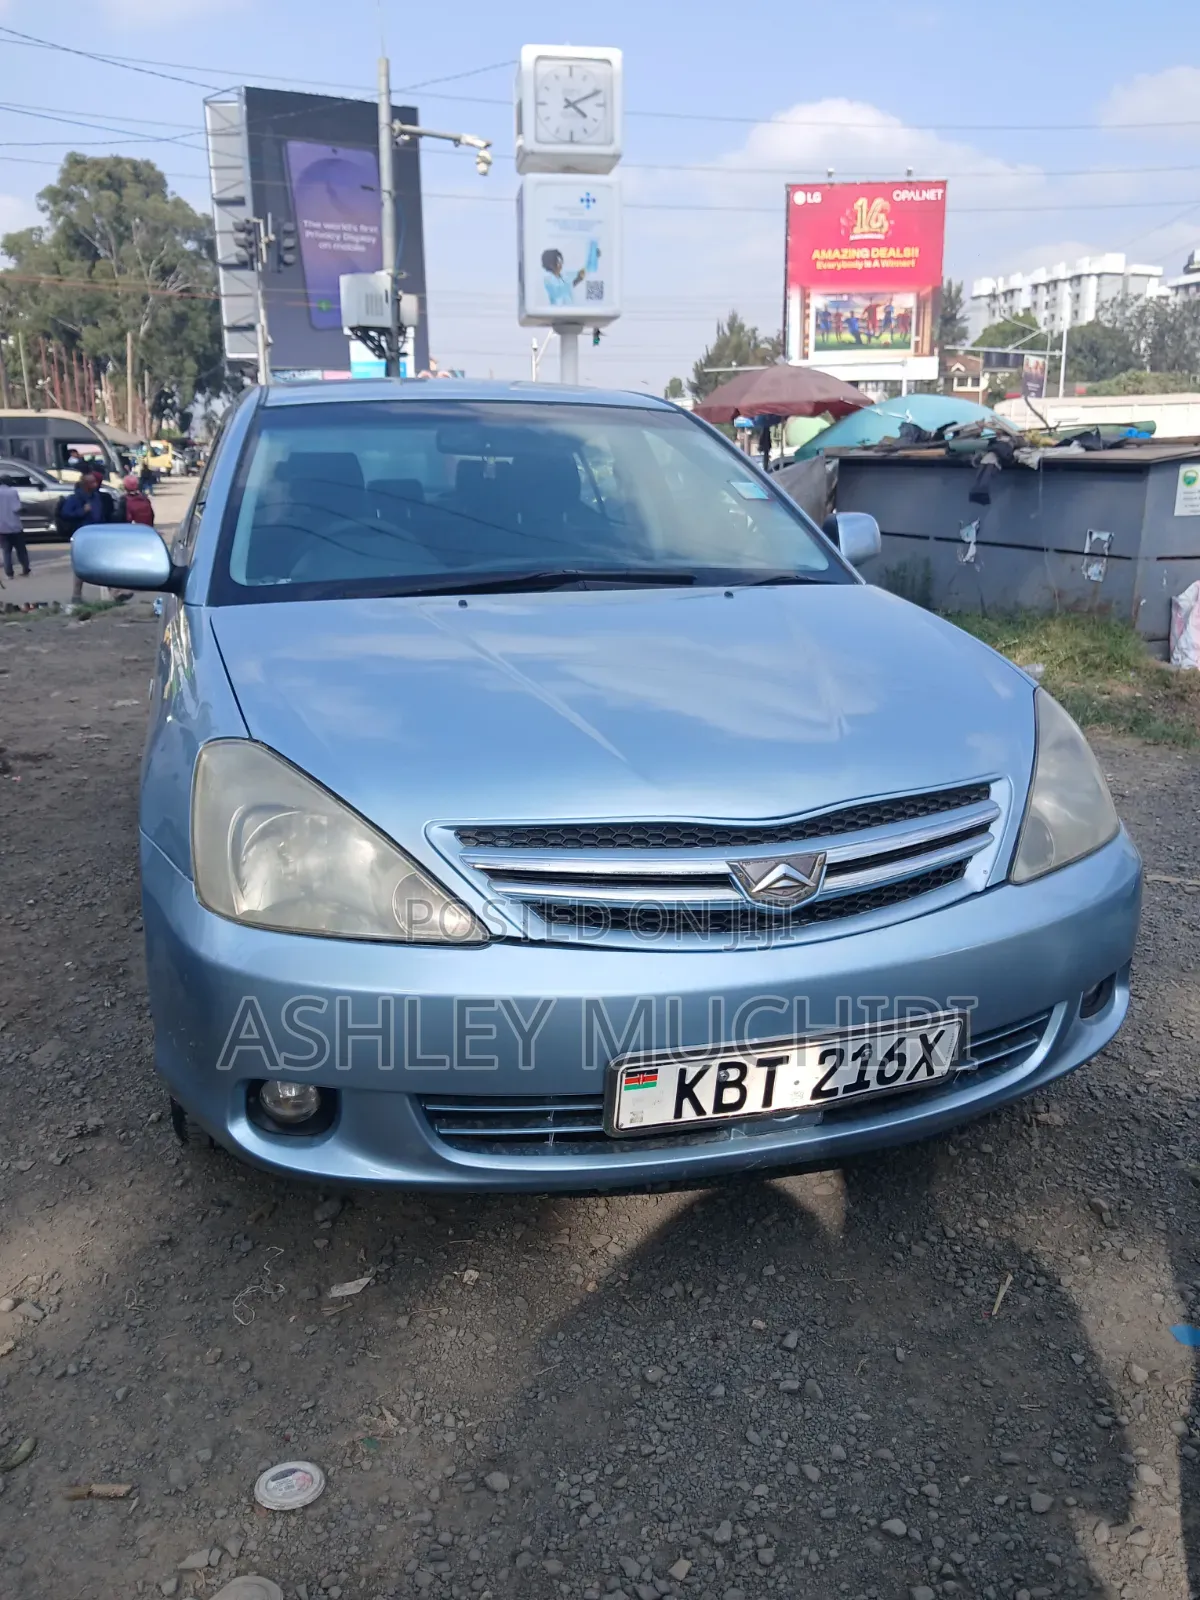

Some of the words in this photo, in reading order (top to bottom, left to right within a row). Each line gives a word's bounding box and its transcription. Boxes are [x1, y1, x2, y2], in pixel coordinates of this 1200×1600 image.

[806, 192, 822, 204] LG
[893, 188, 944, 202] OPALNET
[303, 219, 322, 229] The
[322, 223, 359, 232] world's
[359, 224, 378, 233] first
[318, 242, 332, 250] on
[333, 242, 366, 252] mobile
[811, 248, 870, 260] AMAZING
[871, 247, 919, 258] DEALS!!
[816, 260, 863, 271] Everybody
[872, 259, 880, 268] A
[673, 1055, 789, 1119] KBT
[810, 1029, 945, 1101] 216X
